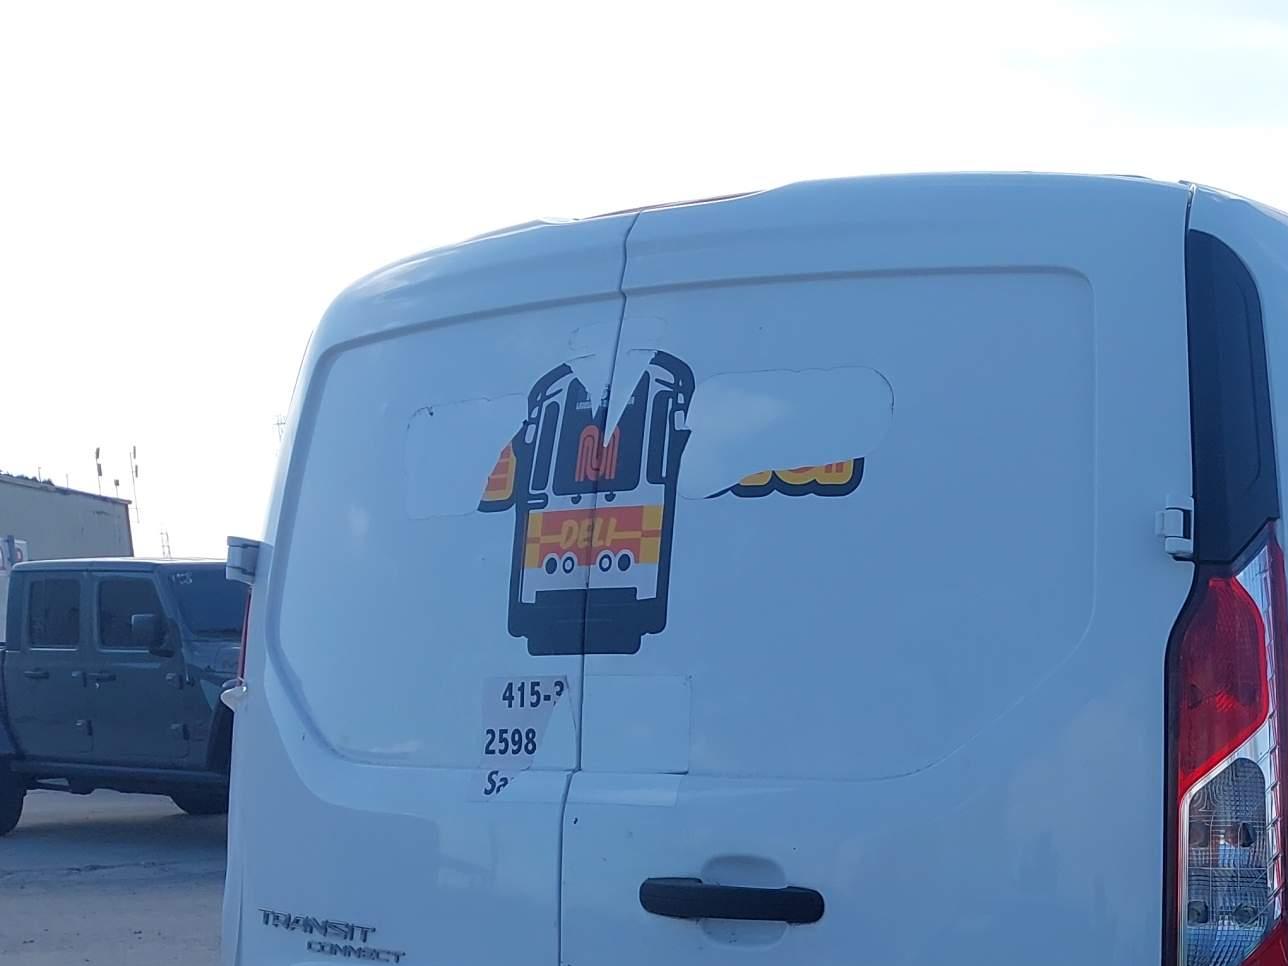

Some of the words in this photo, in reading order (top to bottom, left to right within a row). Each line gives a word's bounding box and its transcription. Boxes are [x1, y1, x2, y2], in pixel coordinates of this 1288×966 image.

[560, 517, 617, 549] DELI
[484, 728, 537, 755] 2598
[258, 908, 376, 943] TRANSIT
[307, 940, 406, 964] CONNECT
